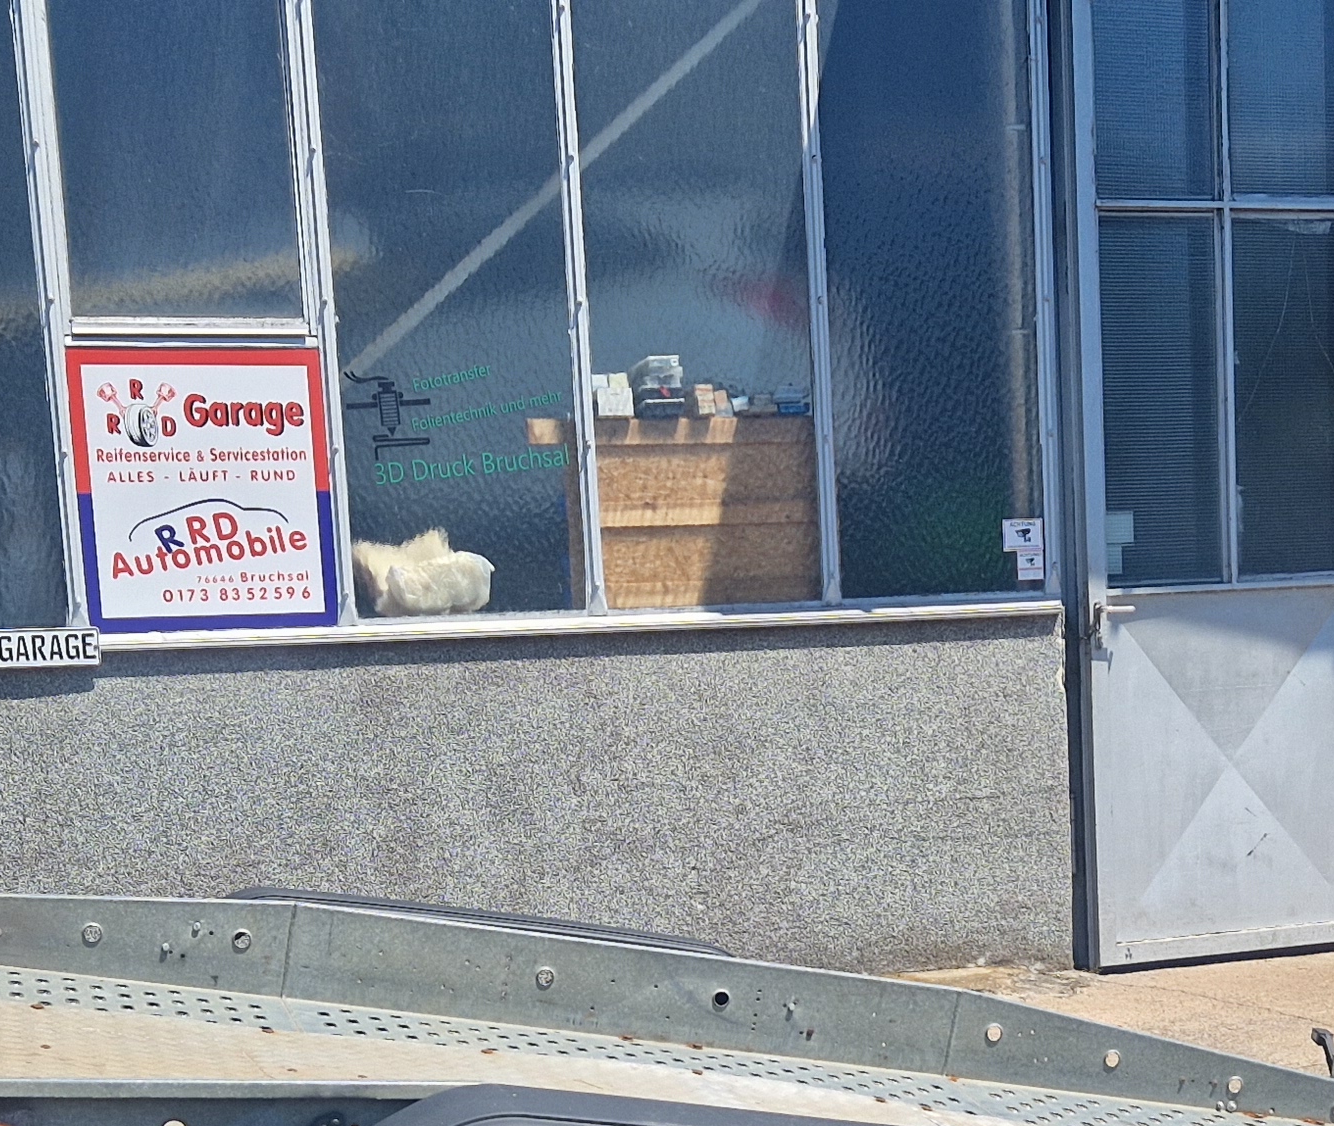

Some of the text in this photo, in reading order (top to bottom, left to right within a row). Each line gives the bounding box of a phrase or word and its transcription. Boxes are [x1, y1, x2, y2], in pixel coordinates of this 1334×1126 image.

[412, 364, 491, 392] Fototransfer
[183, 392, 306, 436] Garage
[411, 391, 563, 432] Folientechnik und mehr
[96, 446, 307, 463] Reifenservice & Servicestation
[375, 444, 570, 486] 3D Druck Bruchsal
[107, 470, 155, 483] ALLES
[179, 467, 230, 482] LÄUFT
[250, 468, 297, 482] RUND
[112, 525, 308, 579] Automobile
[197, 570, 309, 584] 76646 Bruchsal
[163, 586, 311, 603] 0173 8352596
